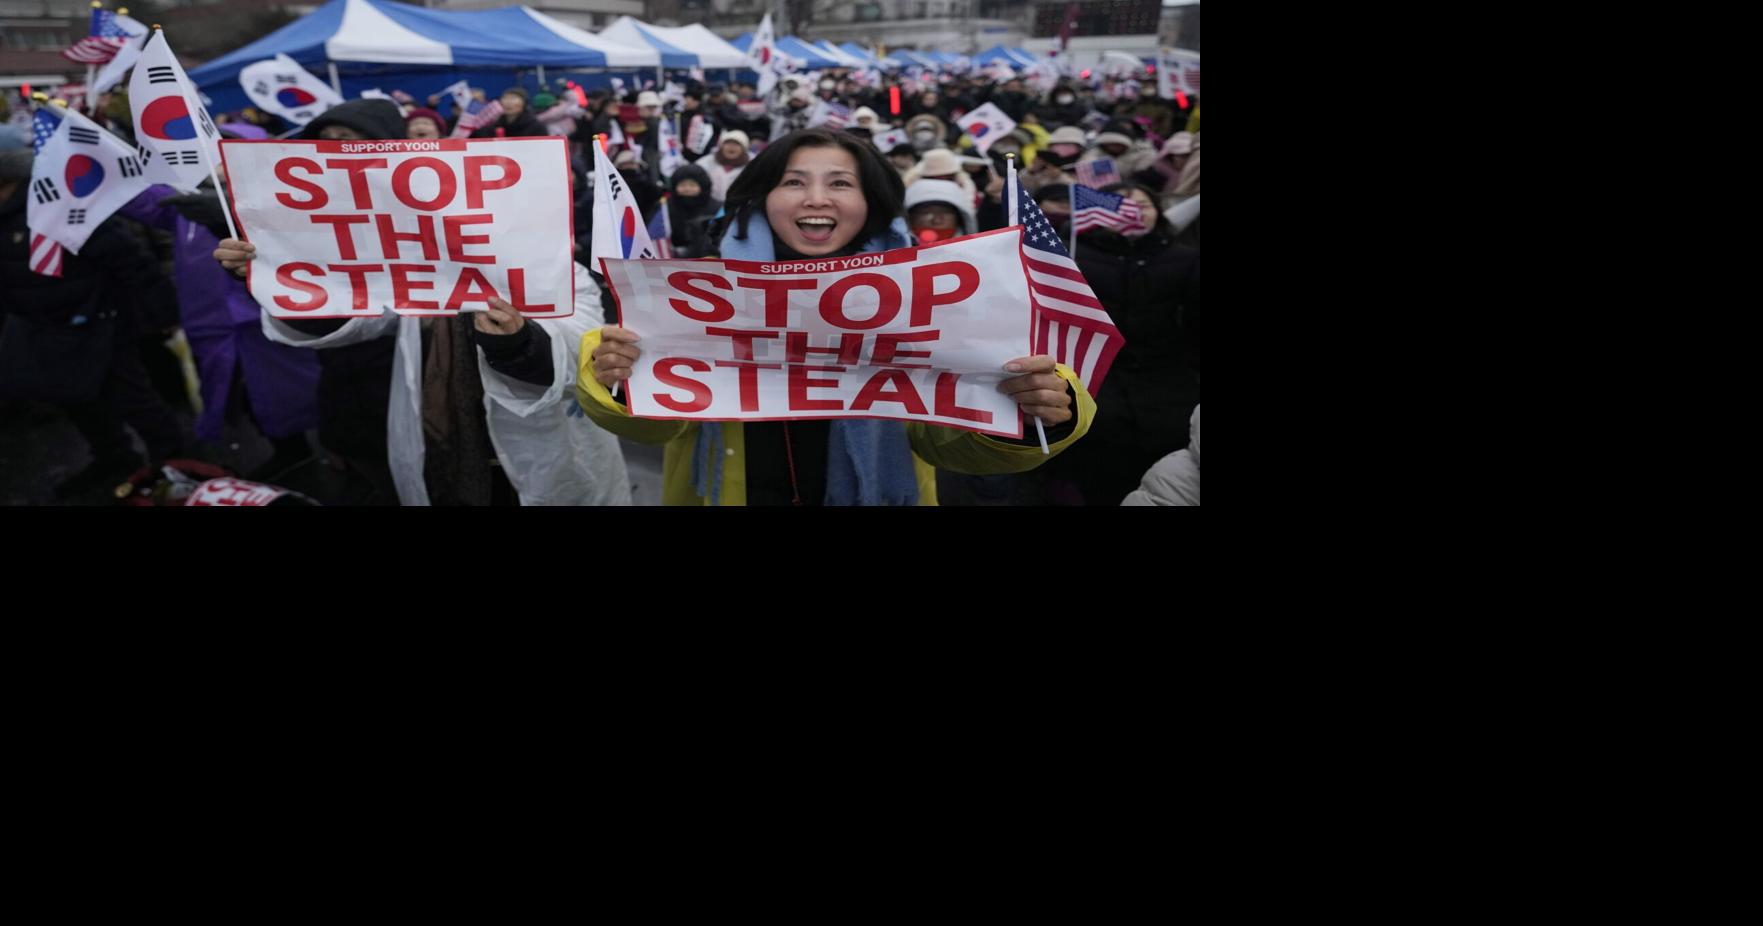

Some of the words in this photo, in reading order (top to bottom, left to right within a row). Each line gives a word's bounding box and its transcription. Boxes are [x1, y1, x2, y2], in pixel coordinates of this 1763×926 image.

[341, 143, 401, 152] SUPPORT
[404, 142, 440, 151] YOON
[274, 156, 522, 211] STOP
[310, 214, 497, 265] THE
[760, 260, 838, 273] SUPPORT
[841, 254, 884, 267] YOON
[273, 262, 556, 313] STEAL
[667, 260, 980, 330] STOP
[705, 325, 940, 369] THE
[652, 357, 993, 424] STEAL
